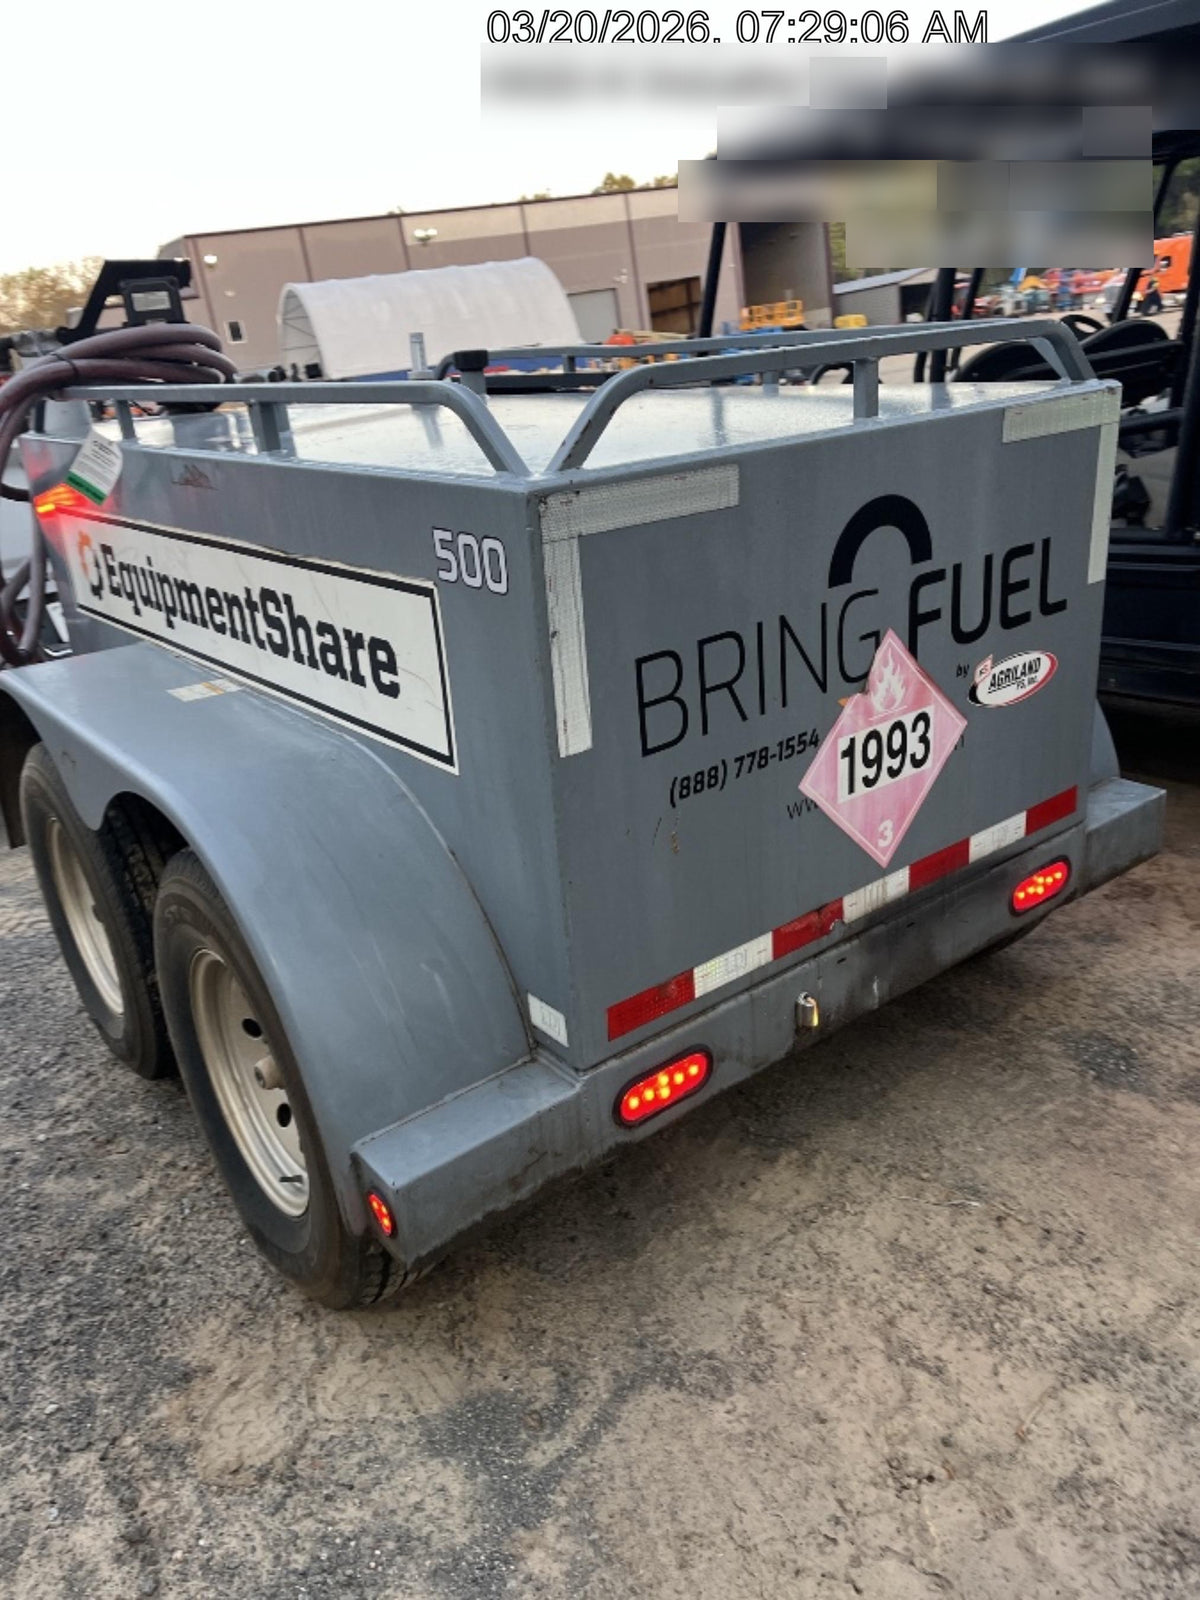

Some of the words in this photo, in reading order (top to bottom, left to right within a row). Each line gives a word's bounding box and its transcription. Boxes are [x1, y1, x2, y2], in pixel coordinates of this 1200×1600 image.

[432, 528, 508, 595] 500
[99, 543, 401, 700] EquipmentShare
[635, 588, 882, 758] BRING
[908, 537, 1068, 660] FUEL
[955, 664, 970, 679] by
[987, 657, 1042, 690] AGRILAND
[669, 758, 728, 809] (888)
[733, 728, 820, 779] 778-1554
[840, 711, 931, 795] 1993
[877, 818, 894, 848] 3
